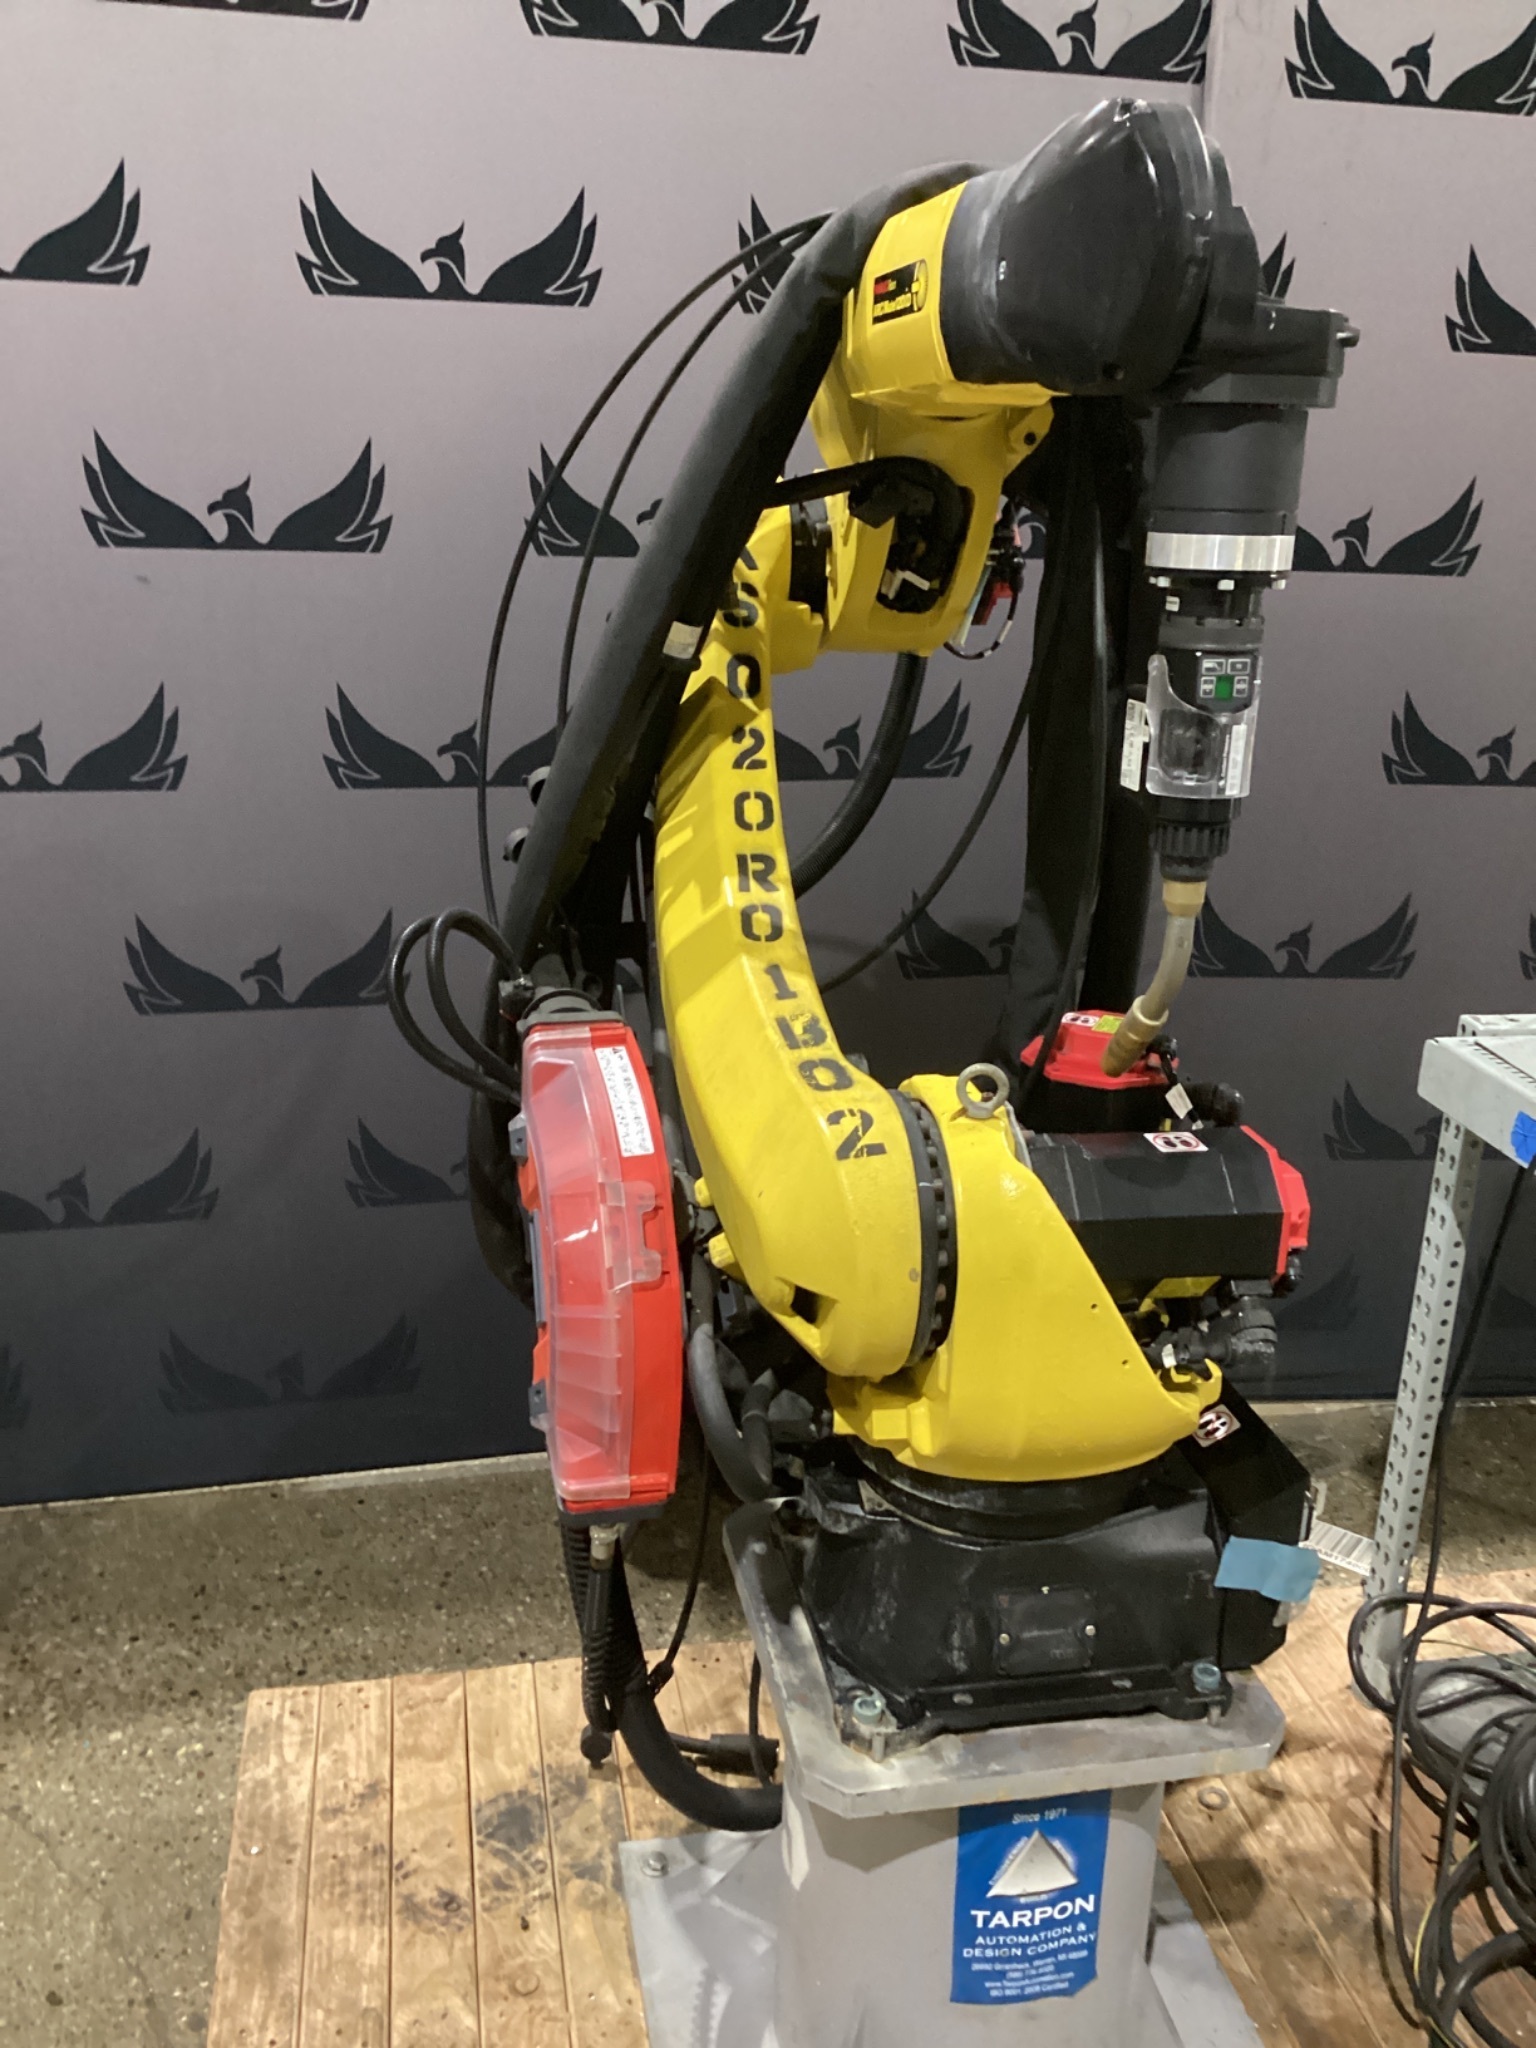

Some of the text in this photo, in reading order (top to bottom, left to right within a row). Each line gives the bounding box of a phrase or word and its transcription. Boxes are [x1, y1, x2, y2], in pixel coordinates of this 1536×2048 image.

[723, 546, 887, 1161] S020R01B02
[1012, 1807, 1068, 1824] Since 1971
[970, 1894, 1095, 1928] TARPON
[963, 1932, 1096, 1958] DESIGN COMPANY
[975, 1921, 1087, 1945] AUTOMATION &
